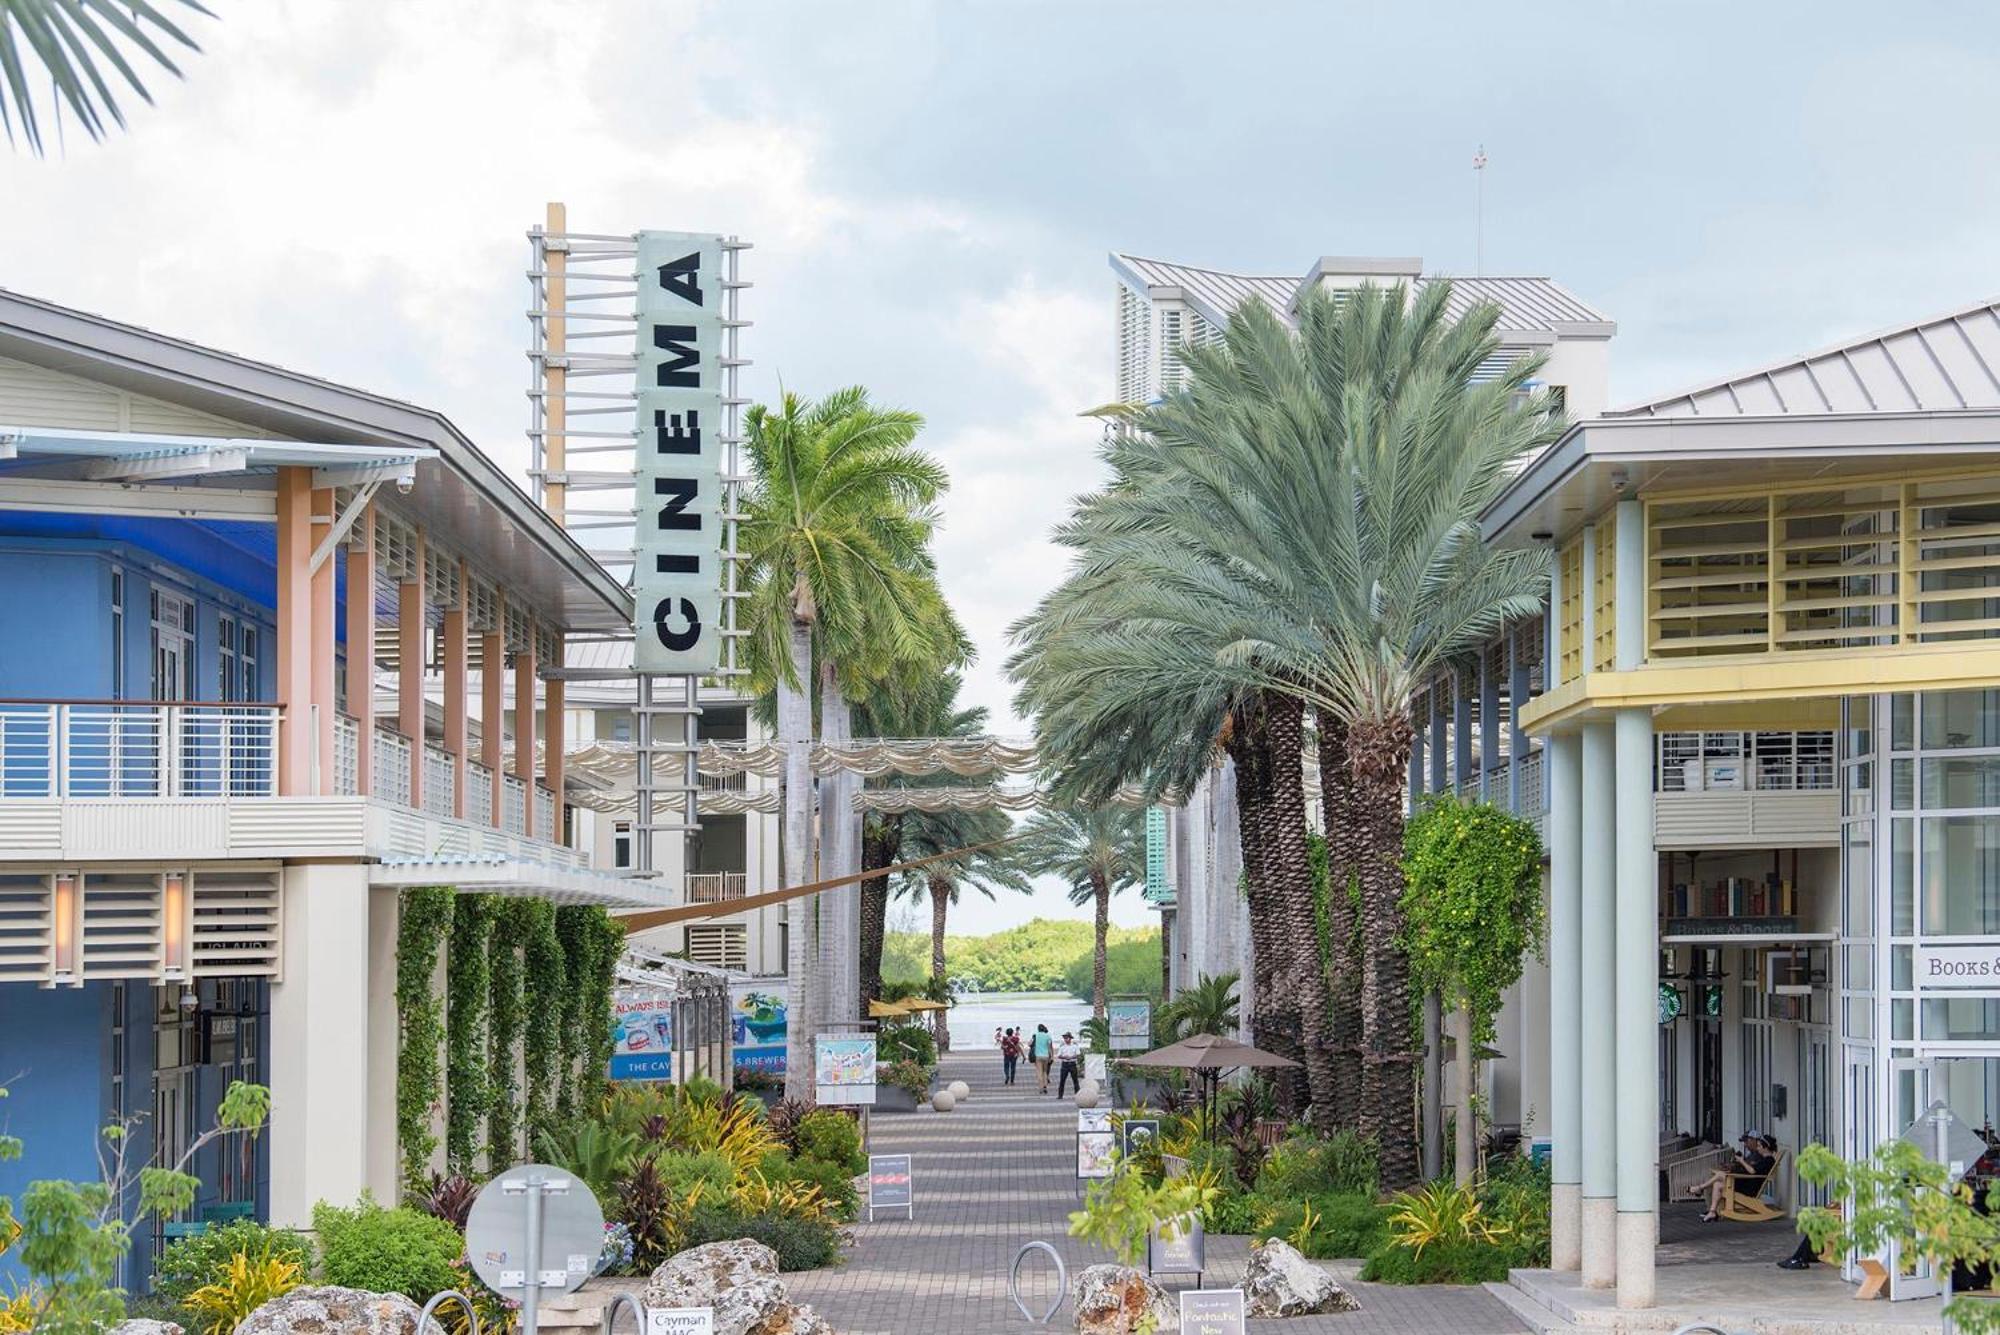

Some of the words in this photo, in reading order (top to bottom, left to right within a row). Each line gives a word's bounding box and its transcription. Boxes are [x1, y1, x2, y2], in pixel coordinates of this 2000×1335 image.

[654, 251, 703, 651] CINEMA
[629, 1062, 648, 1072] THE
[655, 1314, 706, 1329] Cayman
